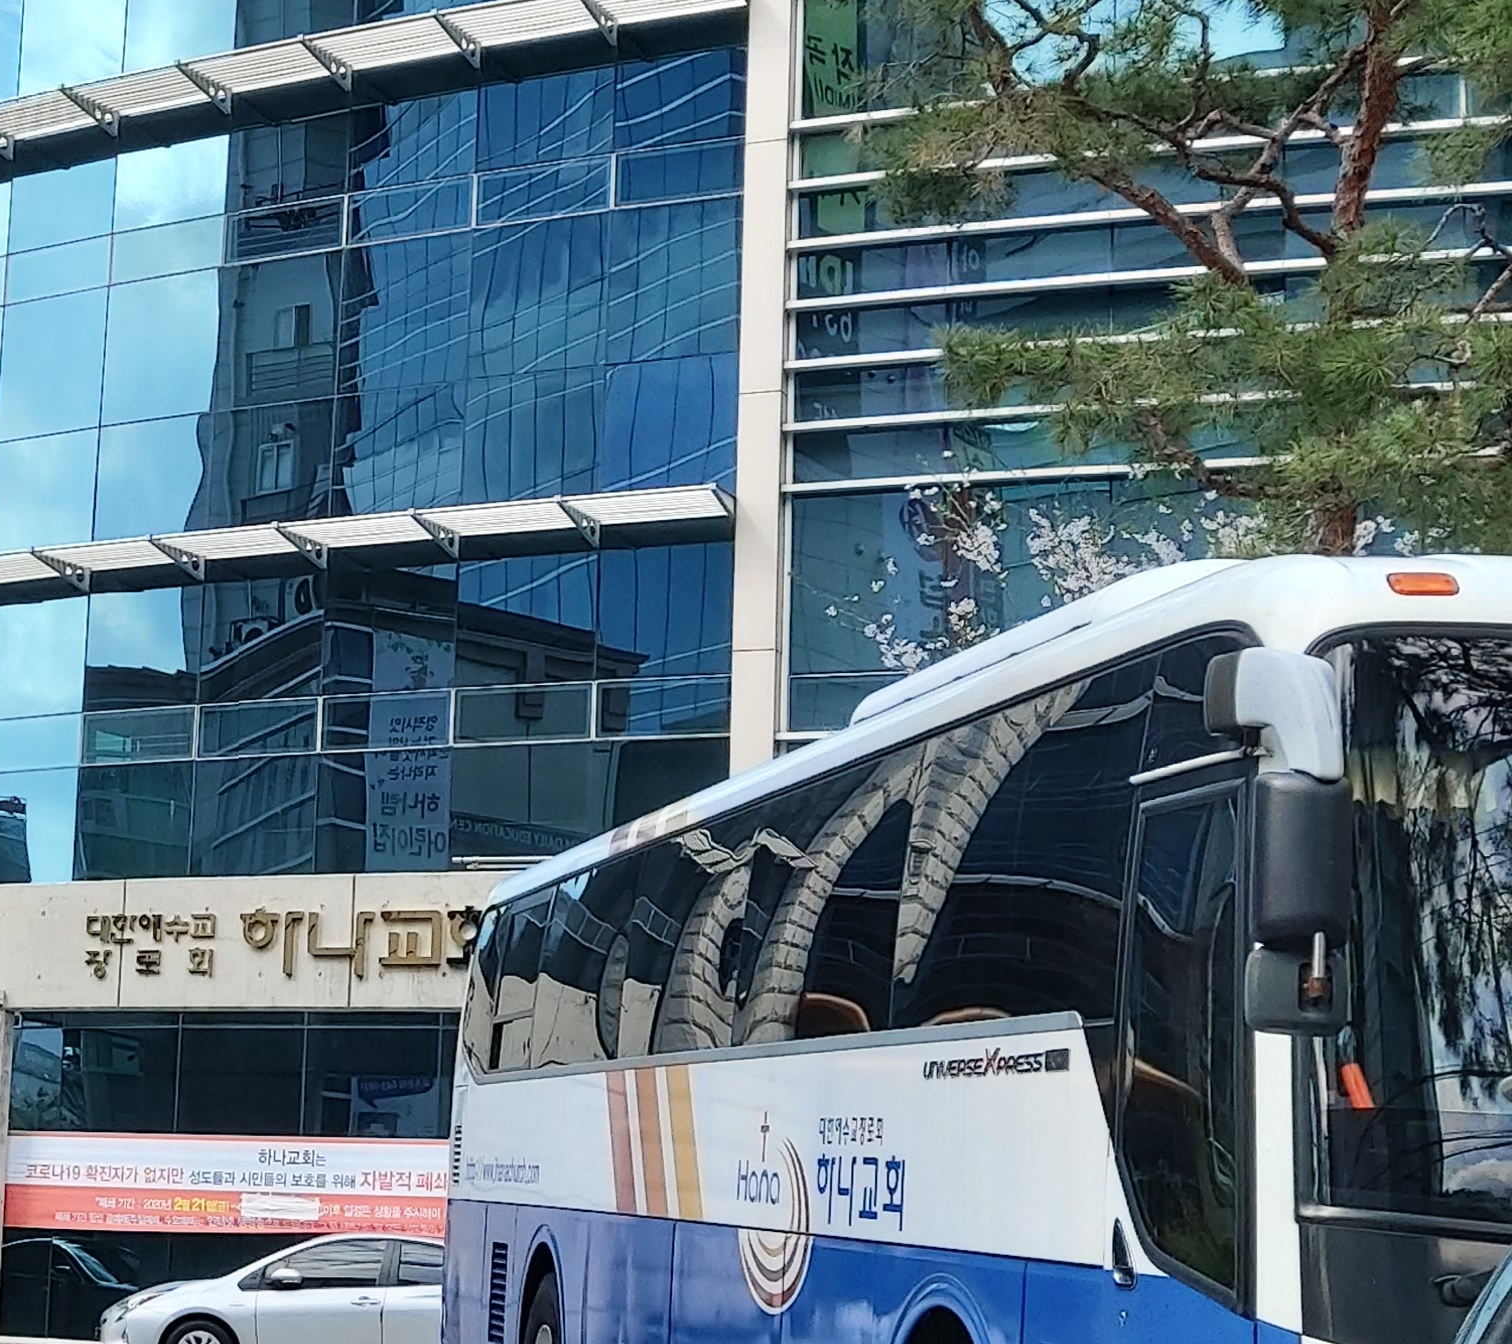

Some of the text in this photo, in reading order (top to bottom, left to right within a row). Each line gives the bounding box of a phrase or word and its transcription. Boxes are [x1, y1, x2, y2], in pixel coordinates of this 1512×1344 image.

[258, 1148, 327, 1168] 하나교회는
[25, 1163, 81, 1181] 코로나19
[86, 1164, 139, 1184] 확진자가
[144, 1166, 185, 1185] 없지만
[189, 1170, 236, 1187] 성도들과
[239, 1171, 287, 1188] 시민들의
[291, 1172, 327, 1189] 보호를
[332, 1173, 357, 1190] 위해
[360, 1170, 413, 1192] 자발적
[737, 1158, 782, 1206] Hana
